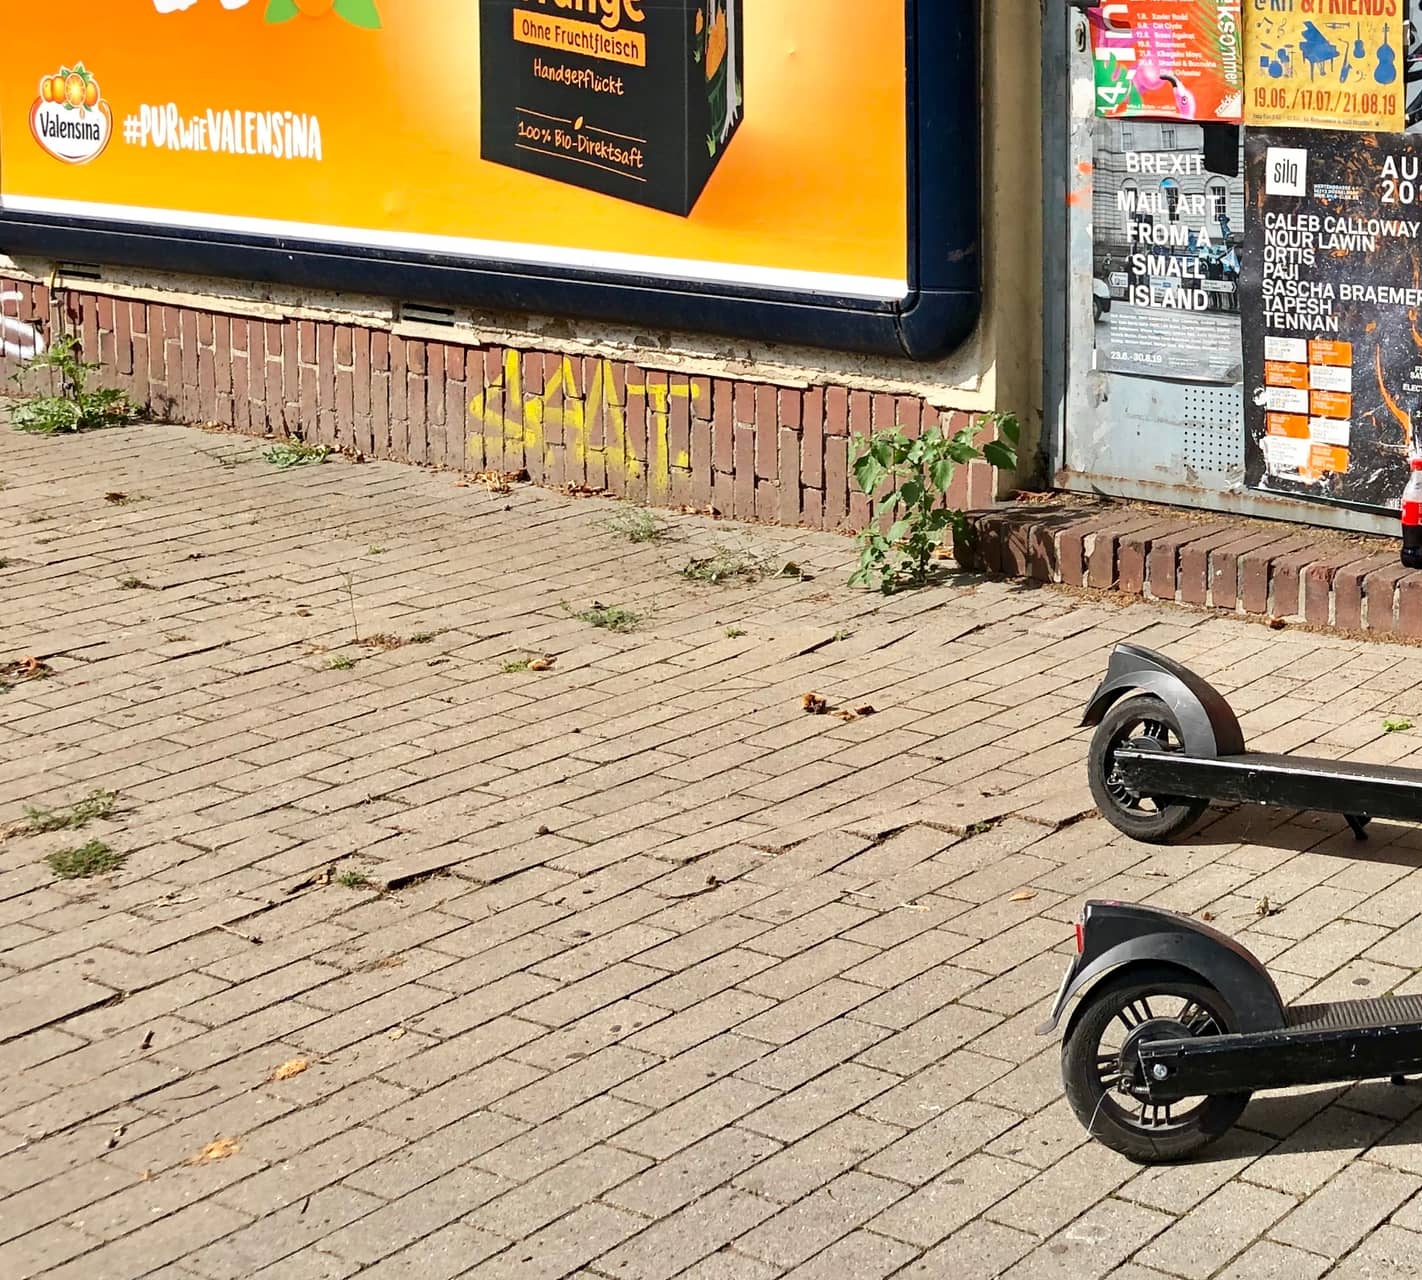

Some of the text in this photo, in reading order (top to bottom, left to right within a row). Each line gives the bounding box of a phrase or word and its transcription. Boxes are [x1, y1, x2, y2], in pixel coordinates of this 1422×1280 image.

[522, 18, 639, 60] Ohne Fruchtfleisch
[1216, 0, 1241, 85] ksommer
[533, 57, 625, 97] Handgepflückt
[39, 112, 100, 142] Valensina
[517, 120, 644, 169] 100% Bio-Direktsaft
[1125, 152, 1206, 176] BREXIT
[1273, 158, 1299, 187] silq
[1117, 190, 1222, 218] MAIL ART
[1126, 221, 1213, 248] FROM A
[1264, 212, 1421, 239] CALEB CALLOWAY
[1264, 230, 1375, 252] NOUR LAWIN
[1131, 254, 1206, 280] SMALL
[1263, 245, 1315, 265] ORTIS
[1263, 262, 1299, 281] PAJI
[1129, 284, 1209, 312] ISLAND
[1262, 278, 1335, 300] SASCHA
[1262, 294, 1333, 315] TAPESH
[1263, 311, 1339, 332] TENNAN
